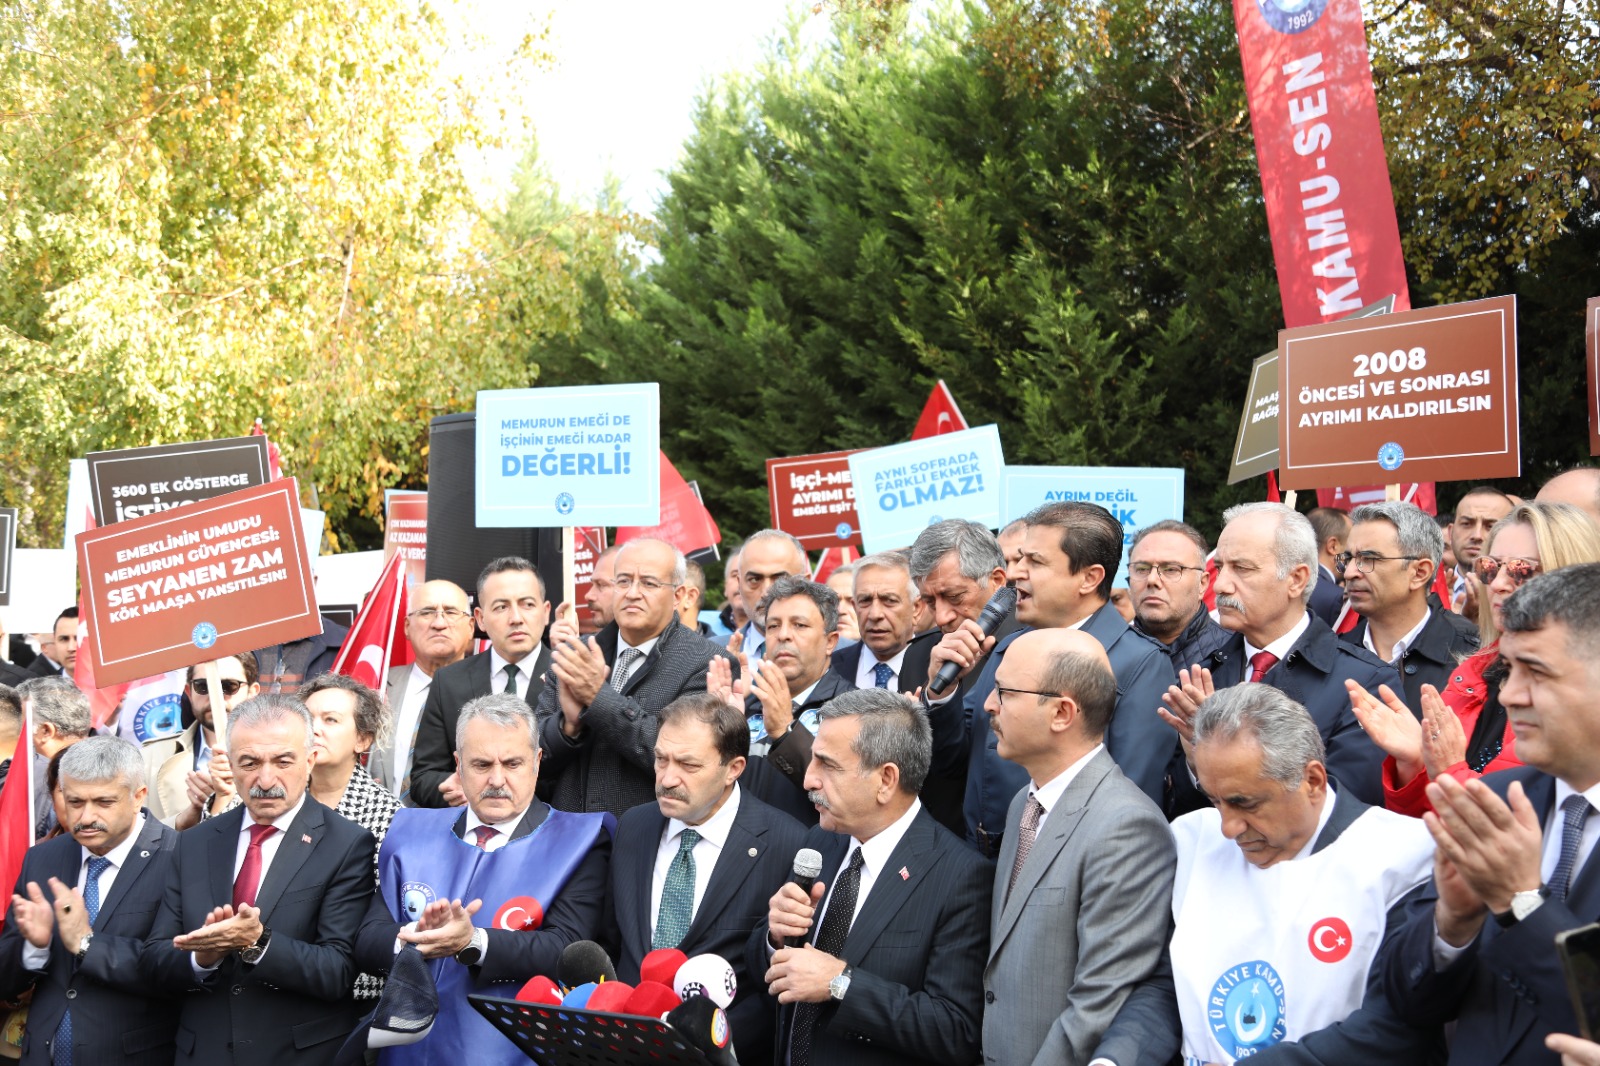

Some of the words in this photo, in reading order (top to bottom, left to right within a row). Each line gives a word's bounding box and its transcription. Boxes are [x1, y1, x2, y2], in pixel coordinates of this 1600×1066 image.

[1288, 10, 1314, 29] 1992
[1282, 52, 1363, 316] KAMU-SEN
[1353, 347, 1426, 377] 2008
[1299, 379, 1365, 404] ÖNCESİ
[1370, 380, 1395, 396] VE
[1400, 369, 1490, 393] SONRASI
[501, 417, 565, 430] MEMURUN
[569, 412, 609, 427] EMEĞİ
[613, 415, 631, 426] DE
[1299, 408, 1361, 427] AYRIMI
[1367, 395, 1491, 421] KALDIRILSIN
[500, 433, 543, 449] İŞÇİNİN
[547, 431, 584, 445] EMEĞİ
[588, 433, 631, 444] KADAR
[502, 444, 631, 477] DEĞERLİ!
[874, 466, 907, 482] AYNI
[910, 451, 979, 474] SOFRADA
[112, 484, 147, 498] 3600
[150, 481, 170, 494] EK
[173, 473, 249, 492] GÖSTERGE
[875, 473, 927, 493] FARKLI
[930, 462, 981, 482] EKMEK
[878, 473, 985, 512] OLMAZ!
[792, 488, 843, 505] AYRIMI
[829, 501, 851, 514] EŞİT
[1045, 491, 1091, 501] AYRIM
[1095, 489, 1138, 502] DEĞİL
[116, 530, 200, 563] EMEKLİNİN
[204, 515, 262, 540] UMUDU
[104, 553, 184, 584] MEMURUN
[187, 526, 280, 562] GÜVENCESİ:
[107, 562, 227, 607] SEYYANEN
[231, 547, 284, 575] ZAM
[109, 607, 140, 623] KÖK
[143, 592, 195, 615] MAAŞA
[197, 568, 287, 600] YANSITILSIN!
